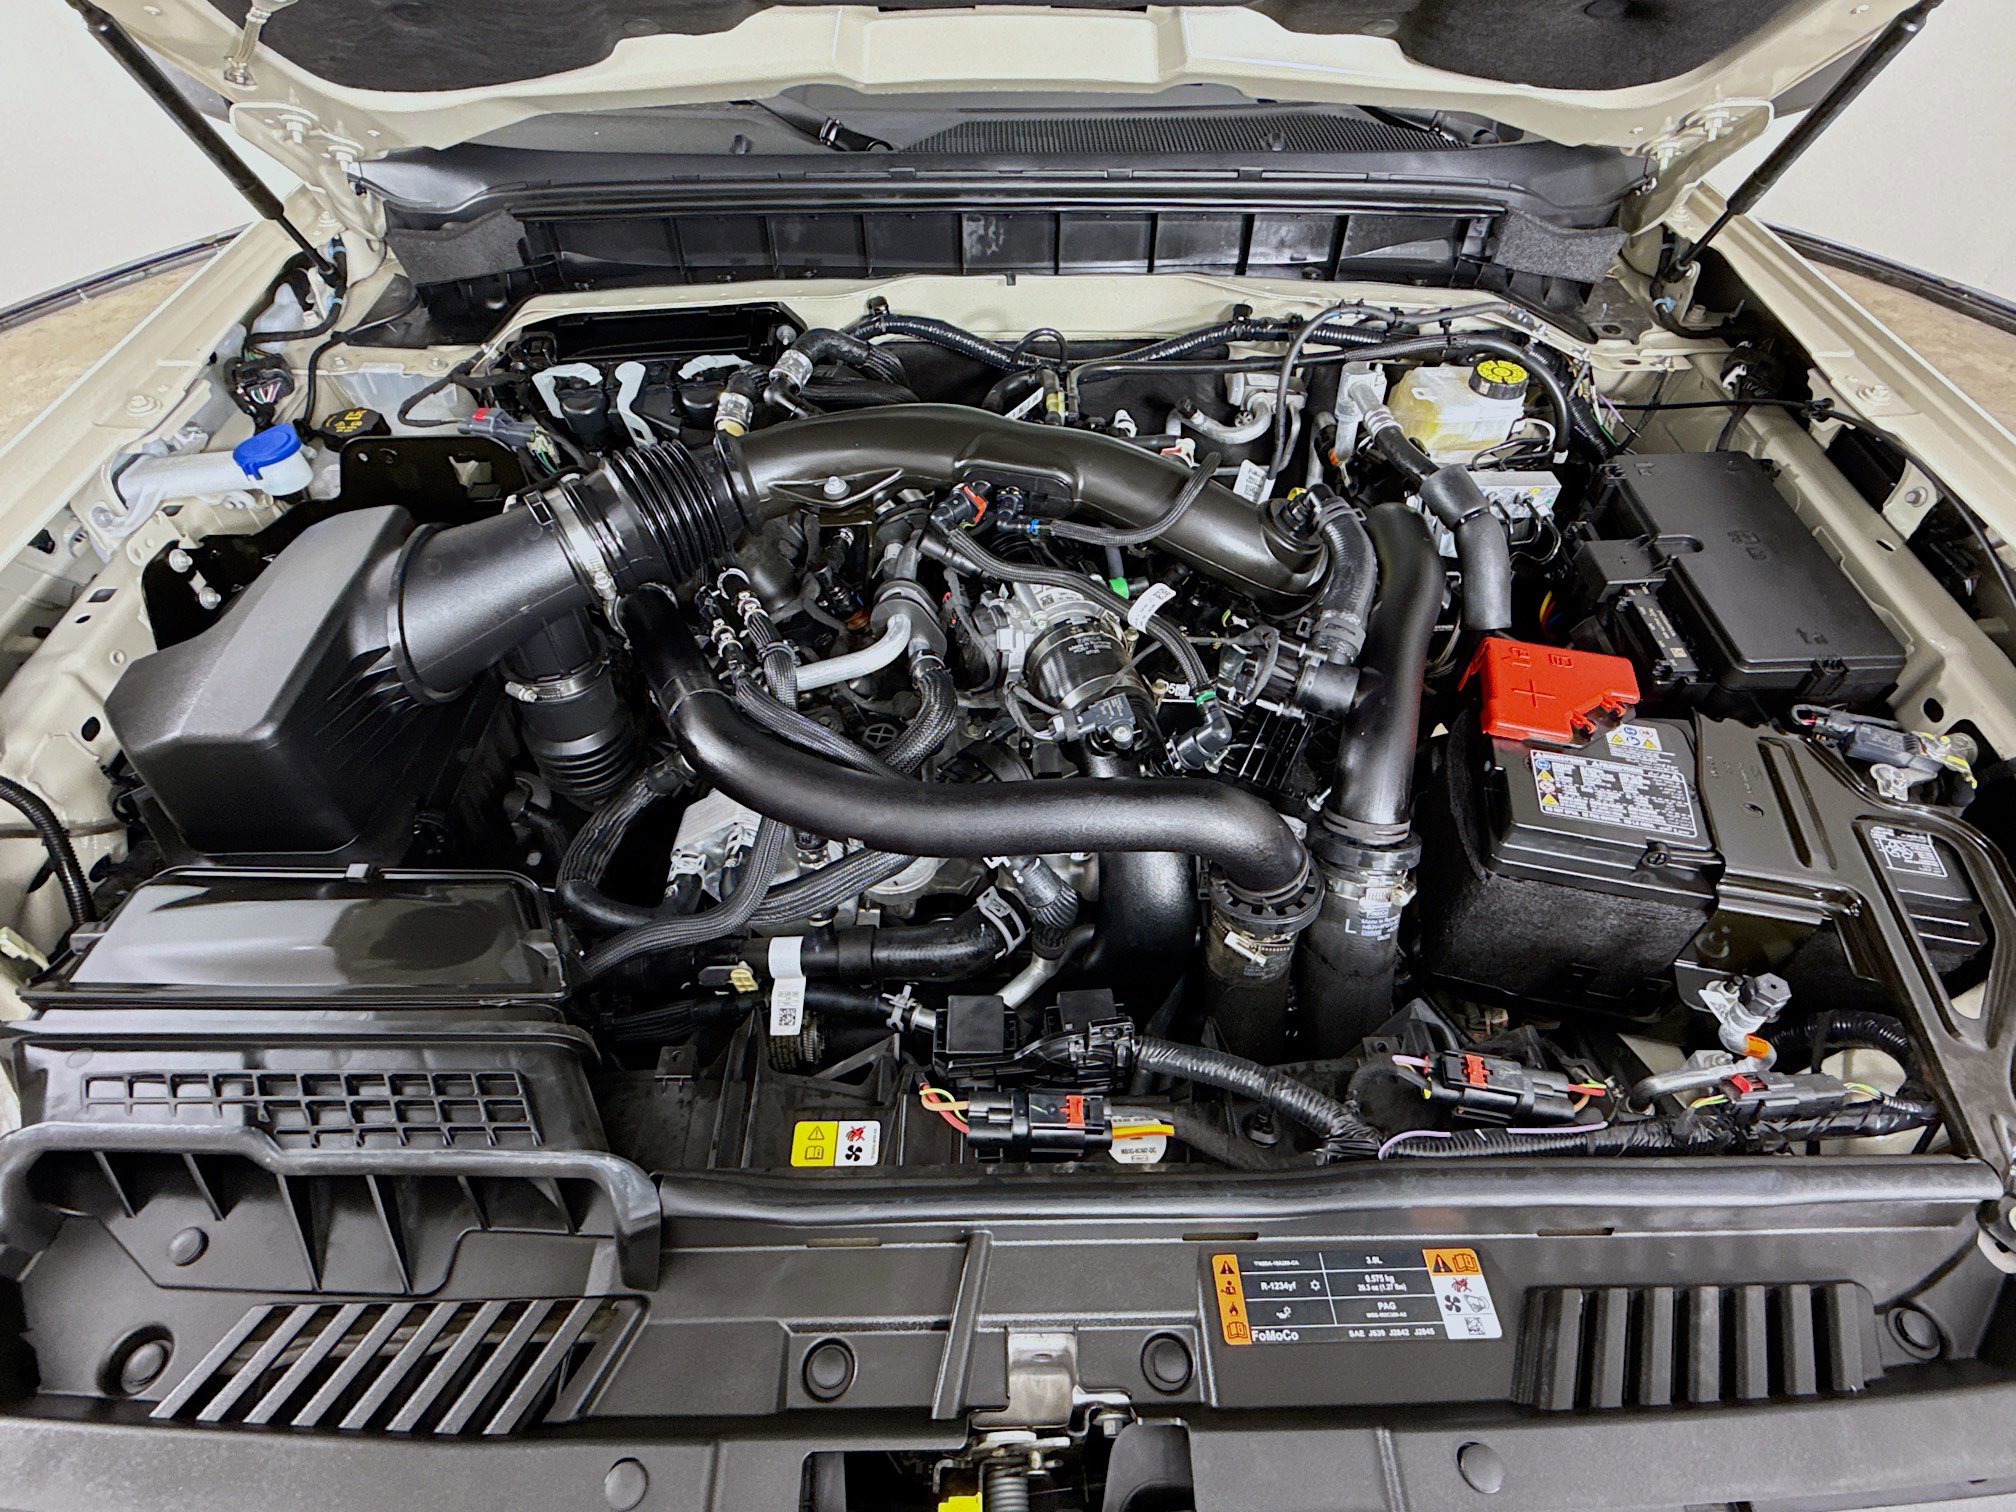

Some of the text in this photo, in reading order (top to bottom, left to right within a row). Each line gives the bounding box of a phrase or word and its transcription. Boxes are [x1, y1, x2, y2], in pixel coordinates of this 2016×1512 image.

[1345, 918, 1357, 934] L
[1260, 1281, 1297, 1292] R-1234yf
[1377, 1302, 1397, 1311] PAG
[1251, 1329, 1300, 1342] FoMoCo
[1348, 1329, 1366, 1338] SAE
